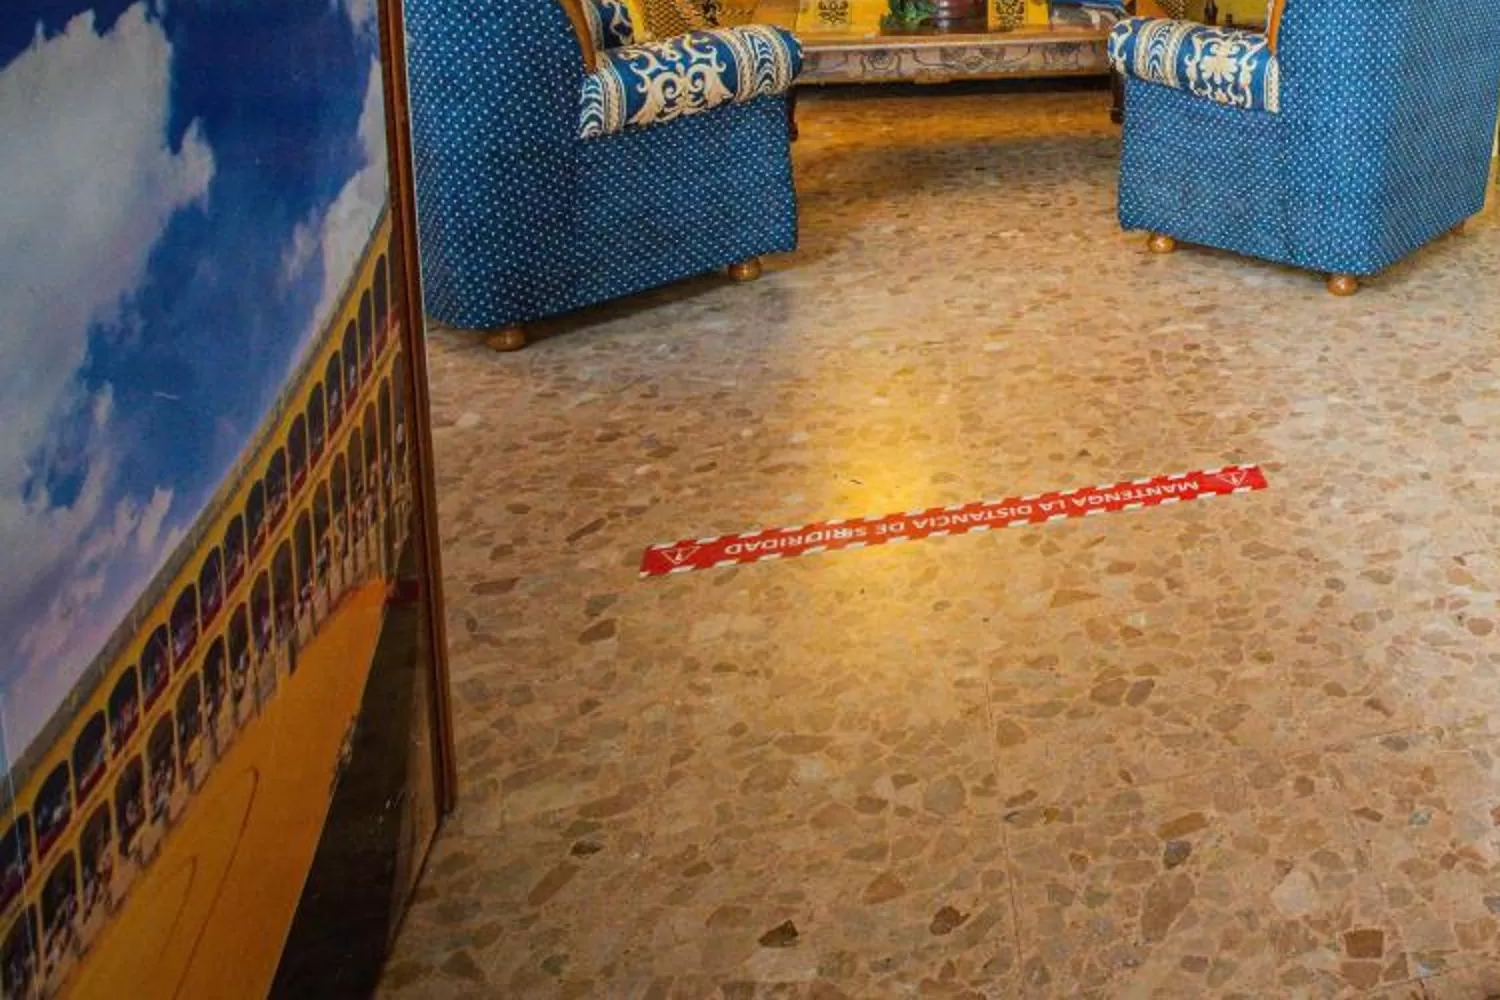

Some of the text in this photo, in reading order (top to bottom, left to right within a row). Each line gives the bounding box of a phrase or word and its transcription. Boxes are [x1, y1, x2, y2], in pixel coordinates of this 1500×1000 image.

[1072, 479, 1199, 508] MANTENGA
[1039, 500, 1066, 512] LA
[912, 504, 1033, 529] DISTANCIA
[875, 522, 905, 534] DE
